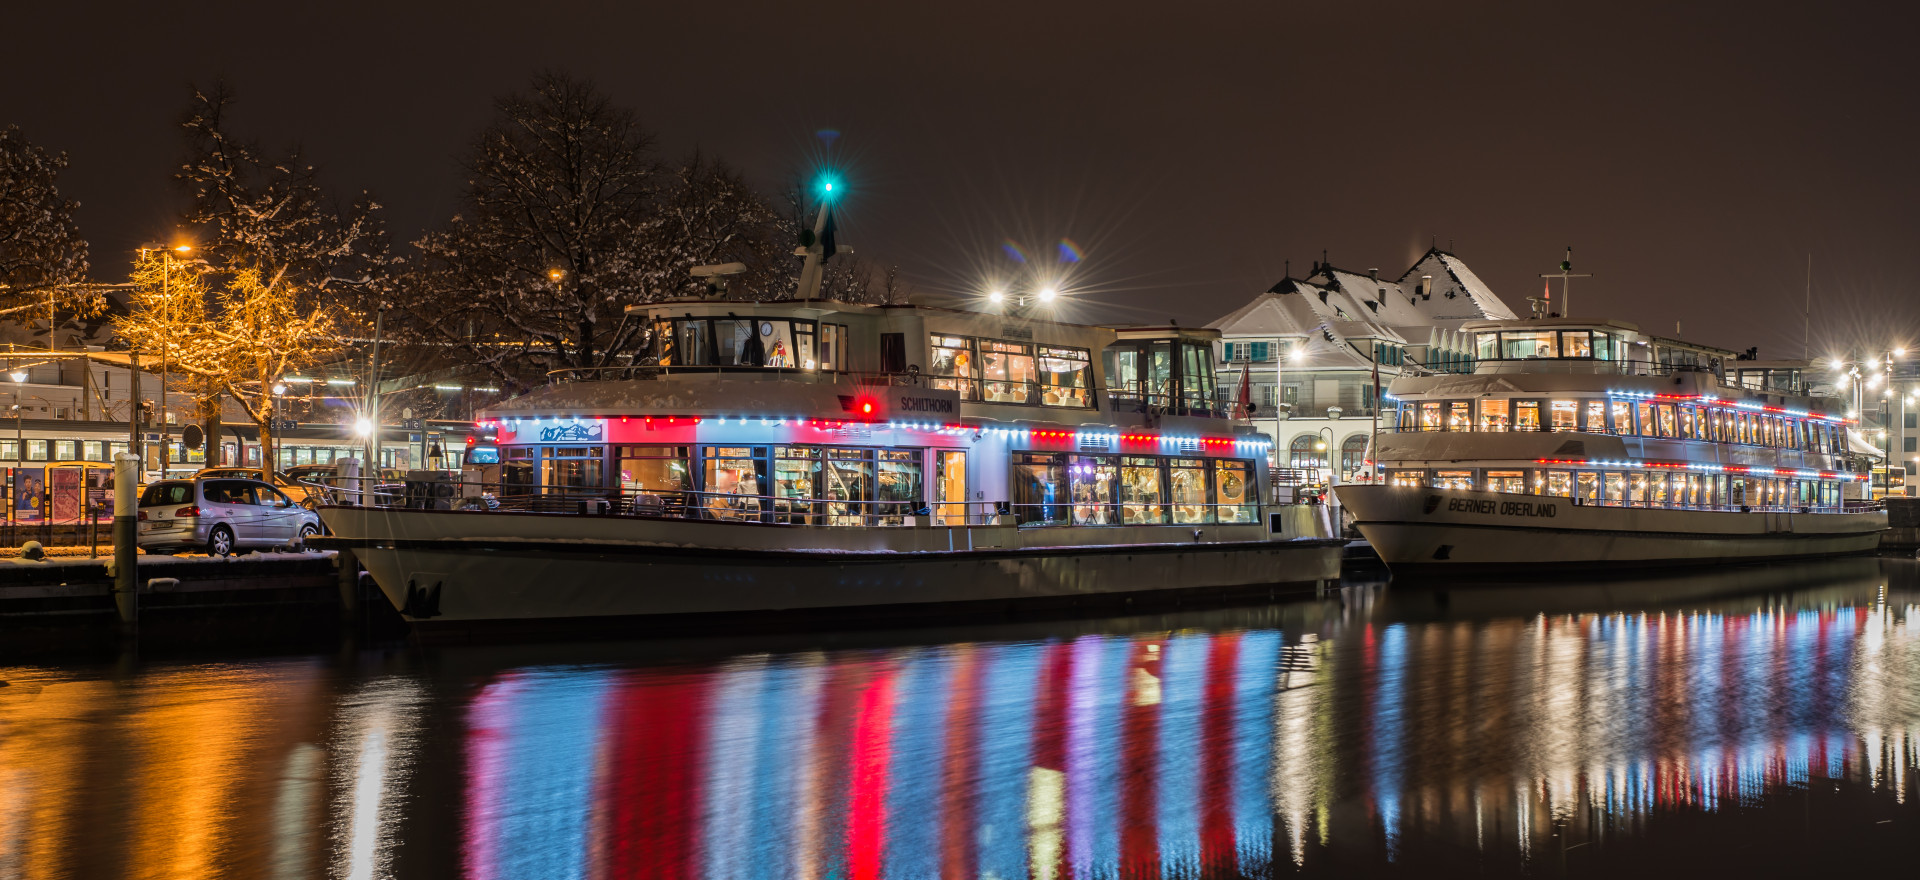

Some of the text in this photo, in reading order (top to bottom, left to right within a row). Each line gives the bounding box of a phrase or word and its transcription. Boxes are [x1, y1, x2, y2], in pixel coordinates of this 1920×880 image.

[901, 396, 953, 413] SCHILTHORN
[1448, 498, 1557, 518] BERNER OBERLAND
